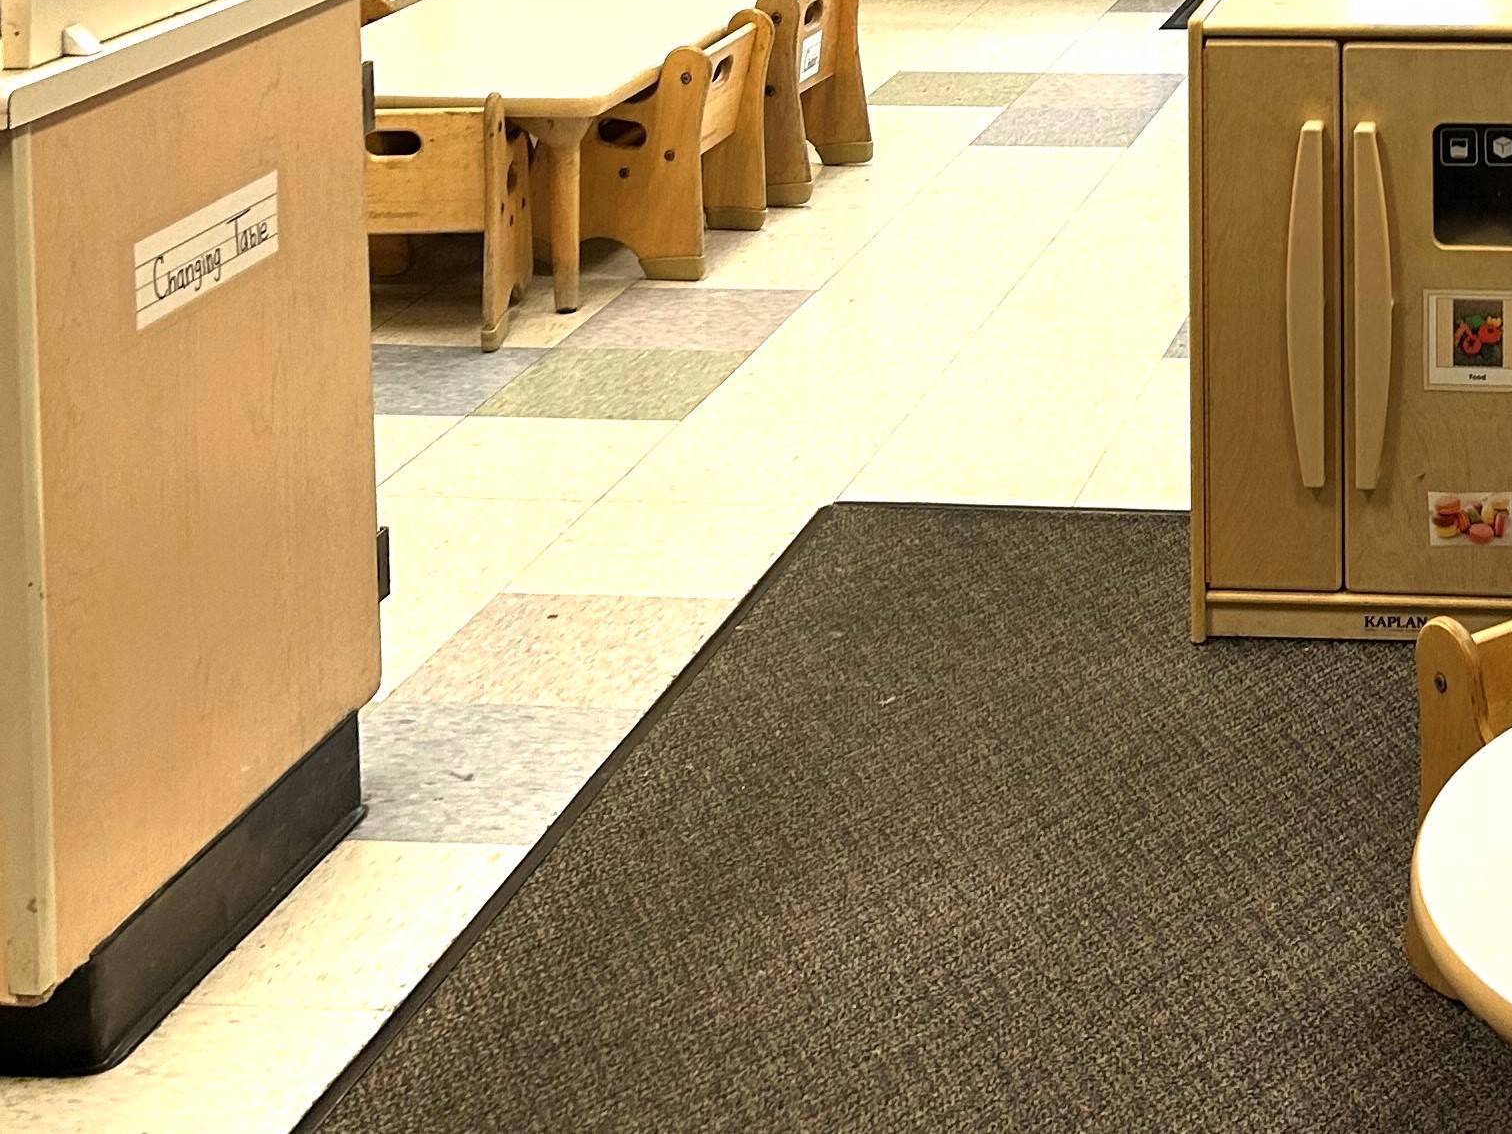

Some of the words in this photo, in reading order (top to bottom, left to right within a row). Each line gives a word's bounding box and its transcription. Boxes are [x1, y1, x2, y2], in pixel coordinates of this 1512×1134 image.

[153, 254, 222, 300] Changing
[226, 207, 269, 257] Table
[1364, 615, 1428, 629] KAPLAN
